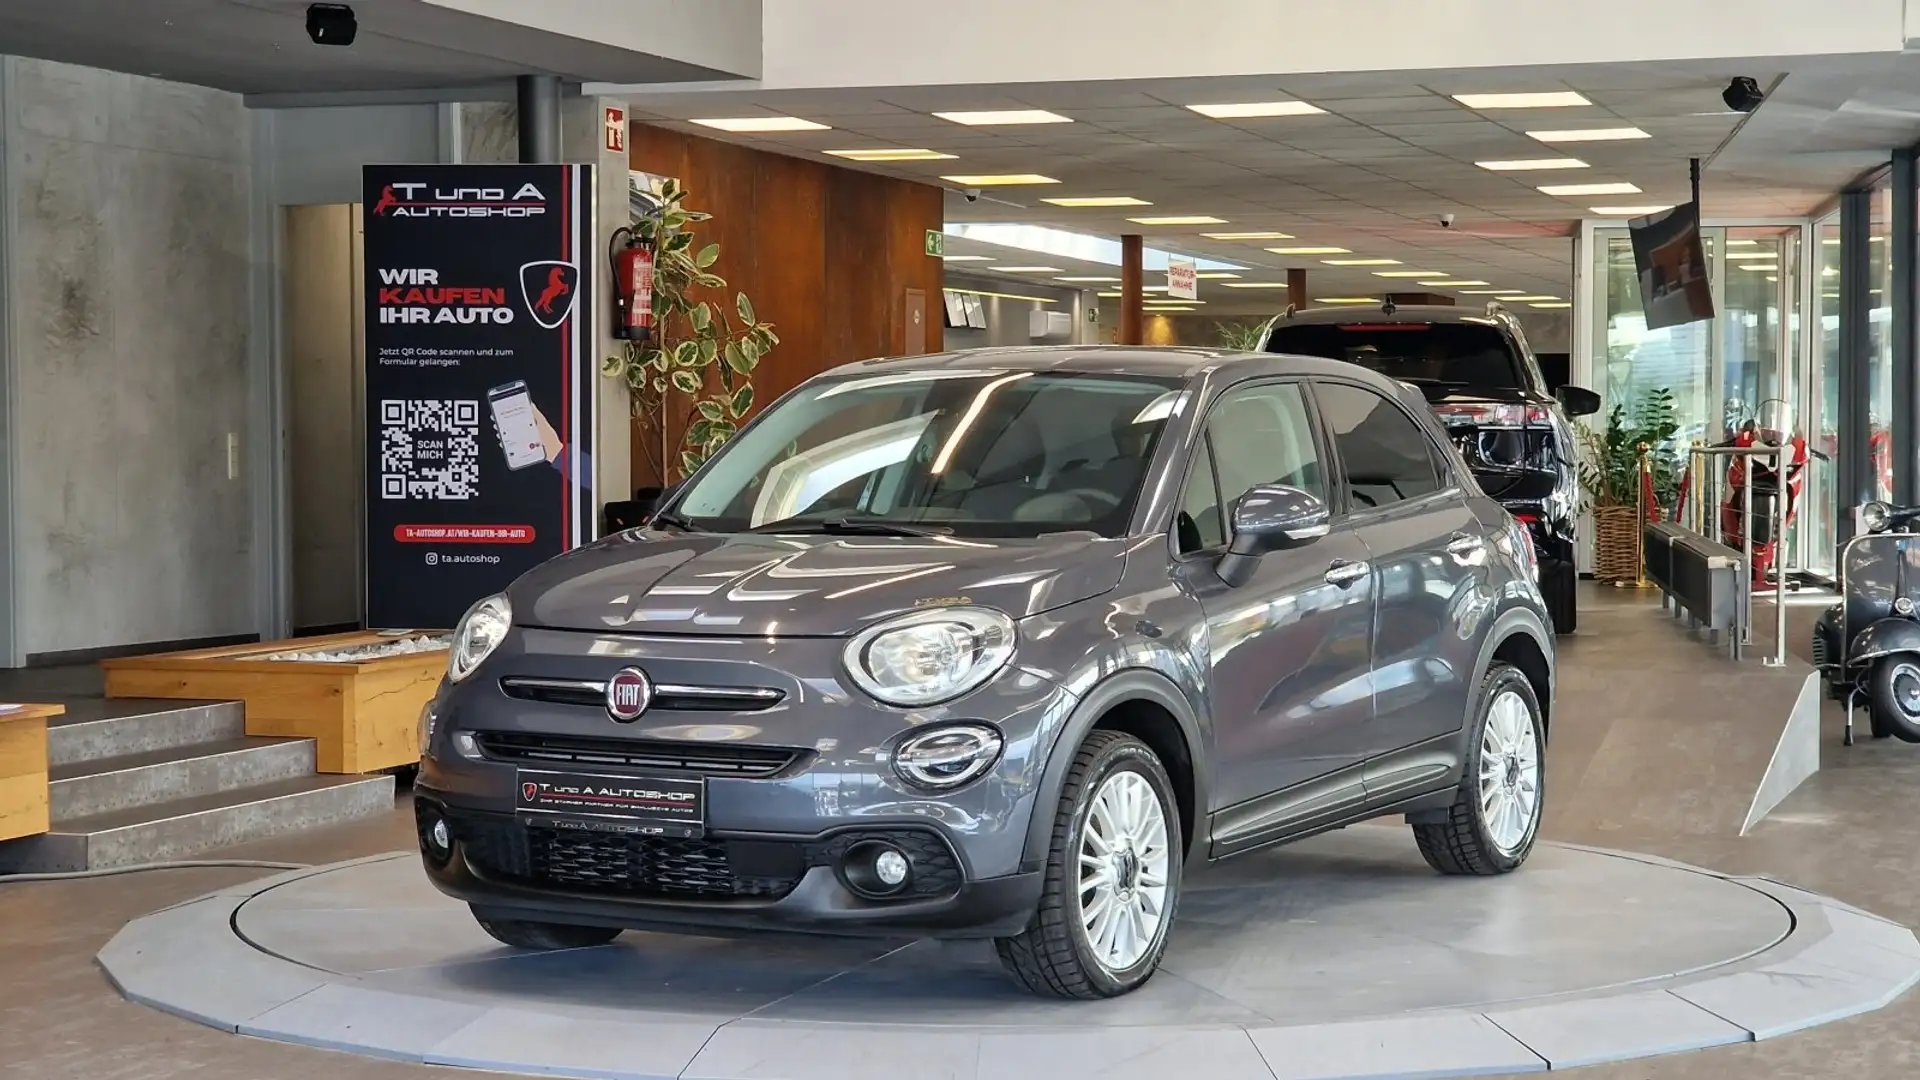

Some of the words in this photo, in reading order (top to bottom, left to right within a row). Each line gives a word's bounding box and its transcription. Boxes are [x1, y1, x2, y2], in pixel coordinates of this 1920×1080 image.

[392, 183, 427, 200] T
[511, 183, 546, 200] A
[392, 207, 546, 217] AUTOSHOP
[378, 269, 439, 285] WIR
[379, 288, 505, 304] KAUFEN
[379, 307, 430, 324] IHR
[433, 307, 514, 324] AUTO
[379, 348, 400, 356] Jetzt
[401, 348, 414, 356] QR
[416, 348, 438, 356] Code
[476, 348, 494, 356] und
[379, 357, 417, 366] Formular
[418, 357, 461, 367] gelangen:
[417, 440, 444, 449] SCAN
[417, 450, 444, 460] MICH
[441, 554, 500, 565] ta.autoshop
[615, 683, 640, 706] FIAT
[539, 783, 550, 791] T
[583, 787, 594, 795] A
[599, 788, 696, 801] AUTOSHOP
